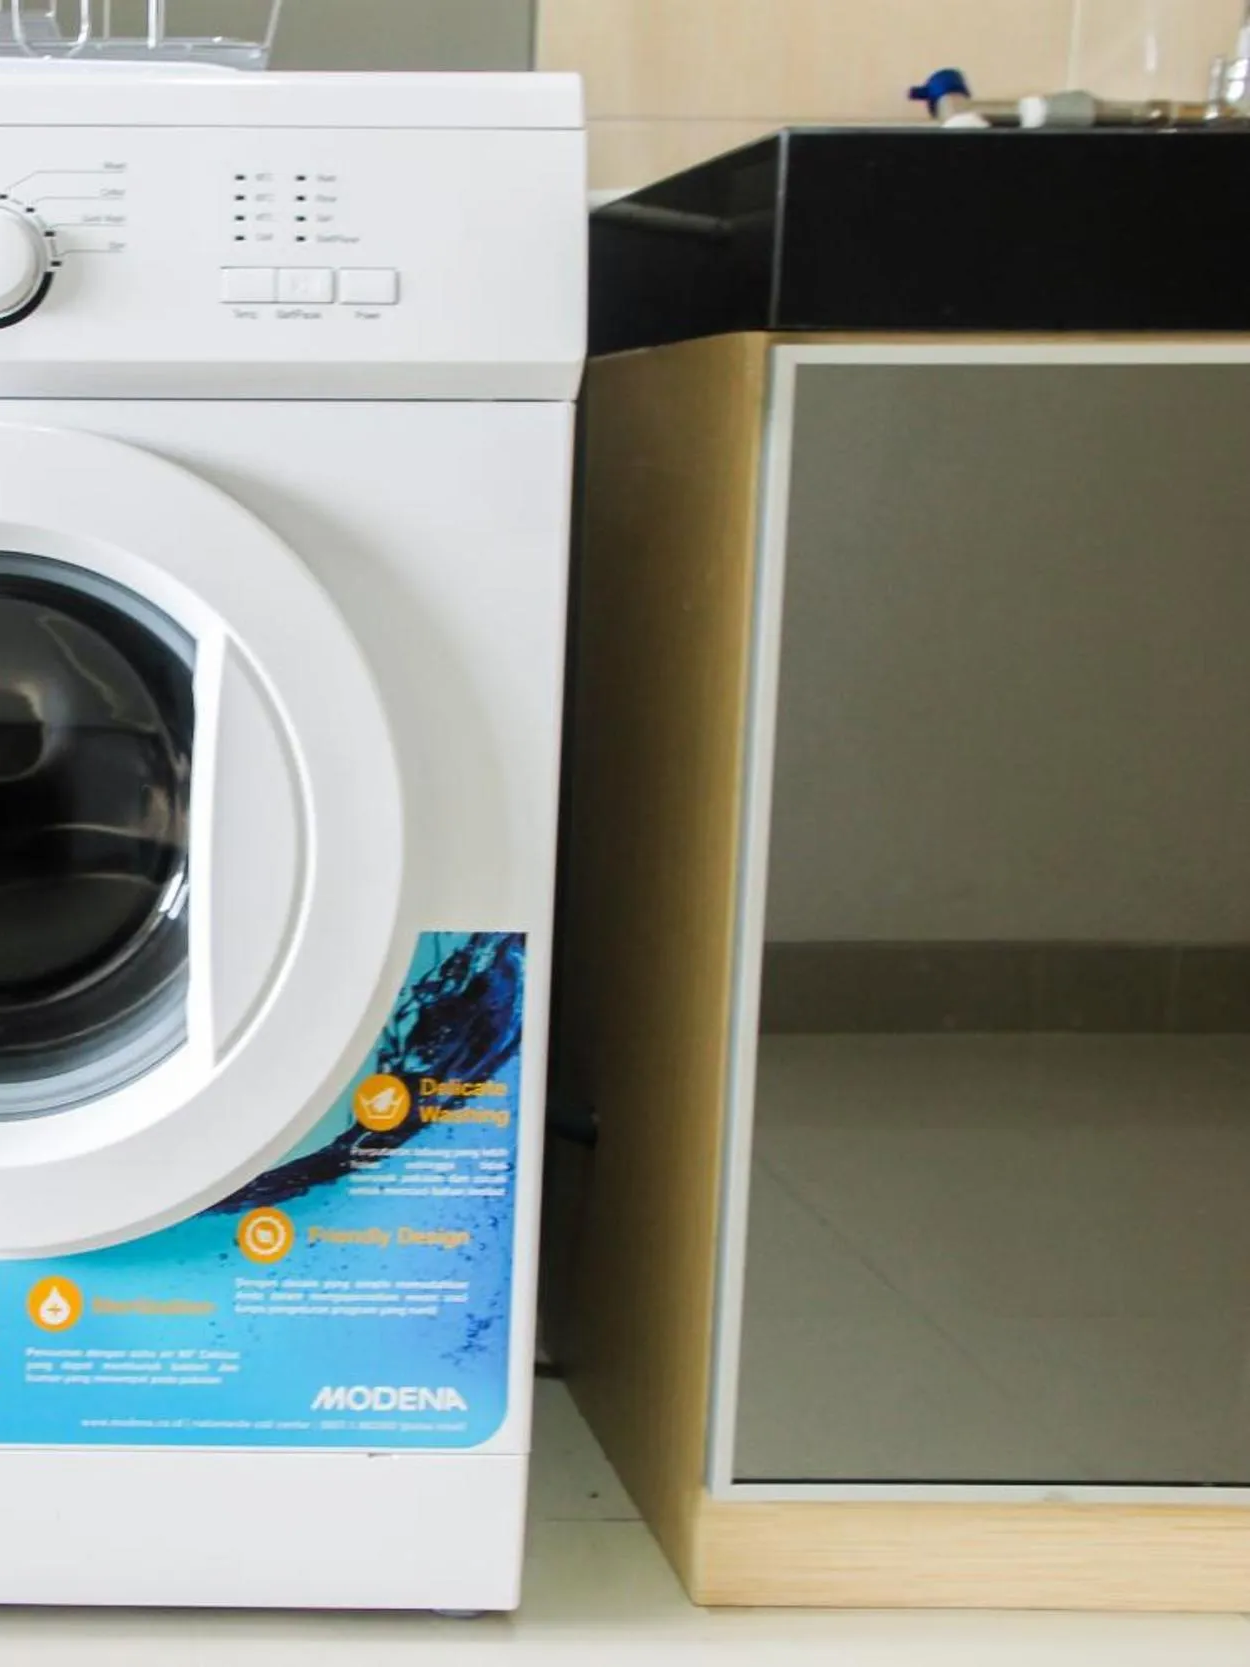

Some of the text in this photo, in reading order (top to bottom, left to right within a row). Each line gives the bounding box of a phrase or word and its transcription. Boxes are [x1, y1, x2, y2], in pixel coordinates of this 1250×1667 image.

[419, 1077, 508, 1096] Delicate
[419, 1106, 510, 1128] Washing
[308, 1226, 470, 1249] Friendly Design
[310, 1386, 468, 1411] MODENA
